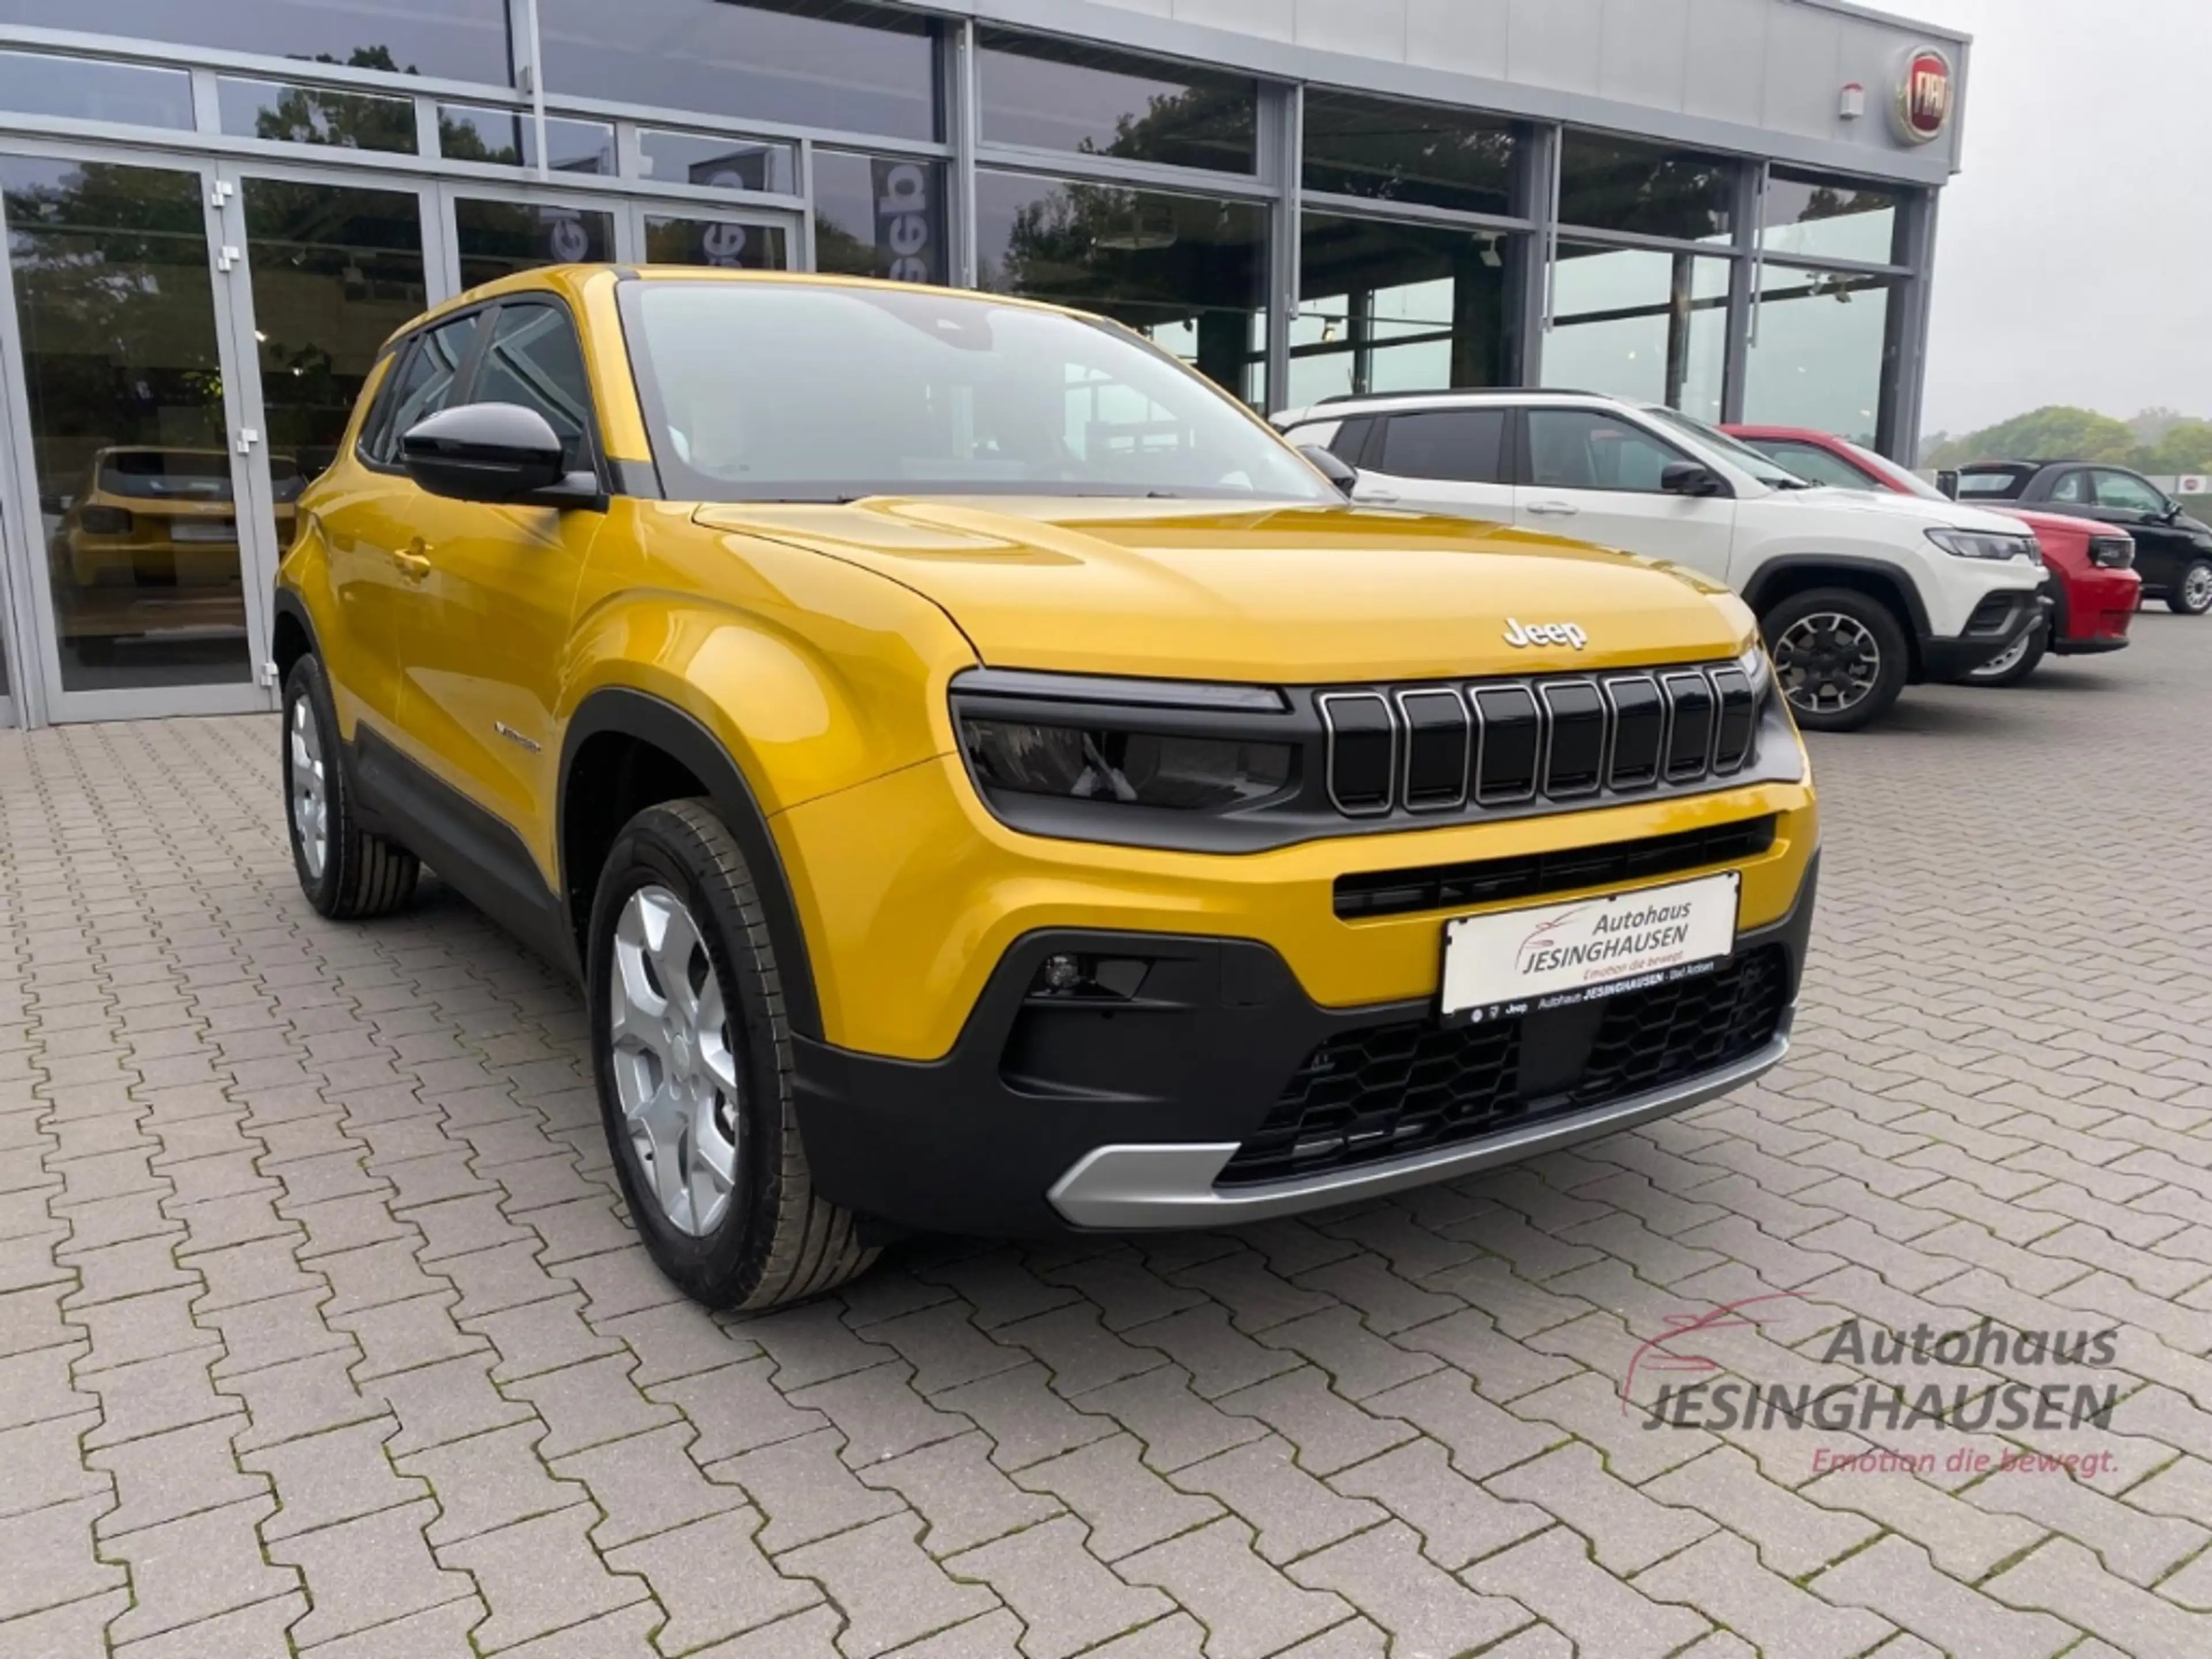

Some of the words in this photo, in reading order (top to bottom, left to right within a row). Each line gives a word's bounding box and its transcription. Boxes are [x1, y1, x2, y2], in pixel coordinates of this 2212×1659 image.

[1501, 617, 1588, 651] Jeep
[1592, 902, 1692, 935] Autohaus
[1522, 923, 1689, 975] JESINGHAUSEN
